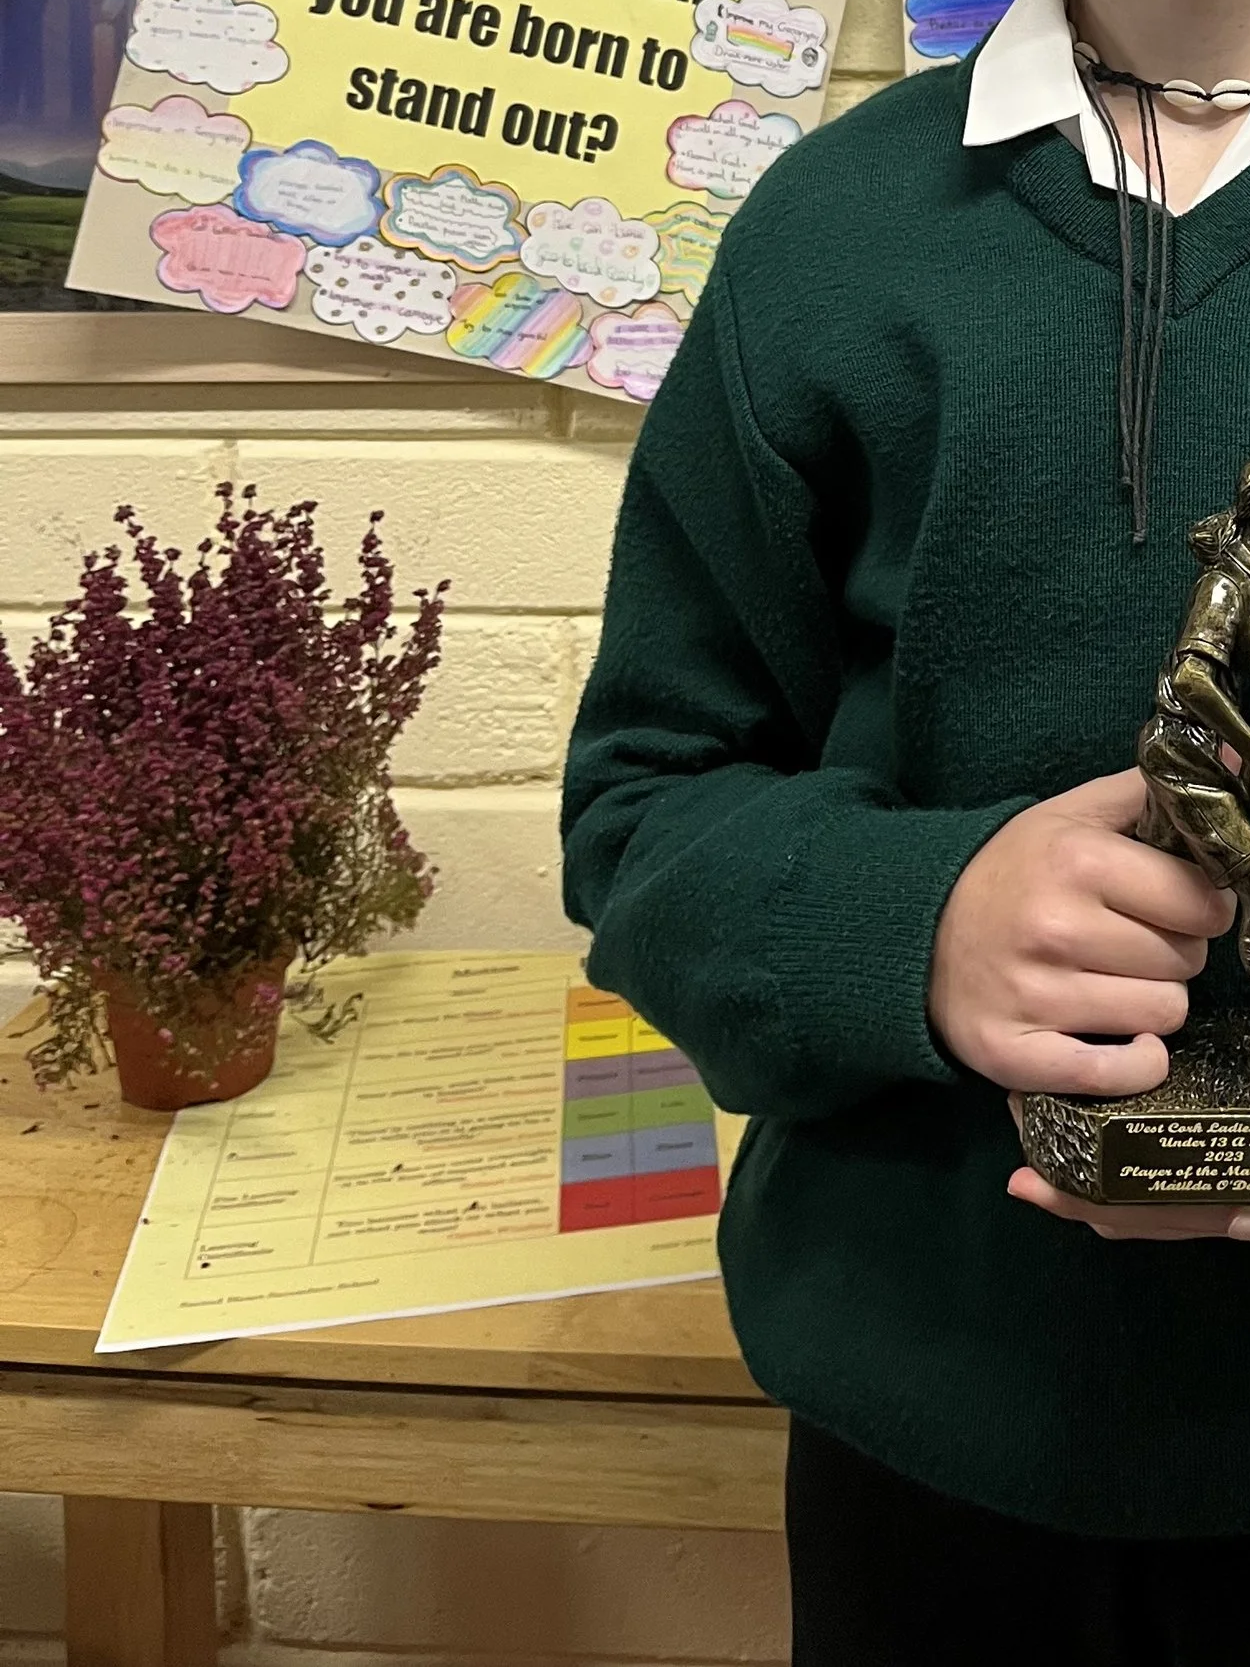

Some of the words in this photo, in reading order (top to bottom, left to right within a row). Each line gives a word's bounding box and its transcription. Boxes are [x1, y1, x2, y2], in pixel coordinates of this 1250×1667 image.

[508, 3, 631, 80] born
[637, 36, 690, 92] to
[346, 65, 497, 139] stand
[500, 102, 620, 165] out?
[1125, 1122, 1166, 1134] West
[1167, 1122, 1204, 1134] Cork
[1159, 1137, 1208, 1148] Under
[1210, 1137, 1228, 1148] 13
[1231, 1137, 1247, 1148] A
[1203, 1151, 1245, 1163] 2023
[1119, 1165, 1173, 1180] Player
[1175, 1165, 1194, 1180] of
[1195, 1165, 1219, 1177] the
[1147, 1179, 1213, 1192] Matilda
